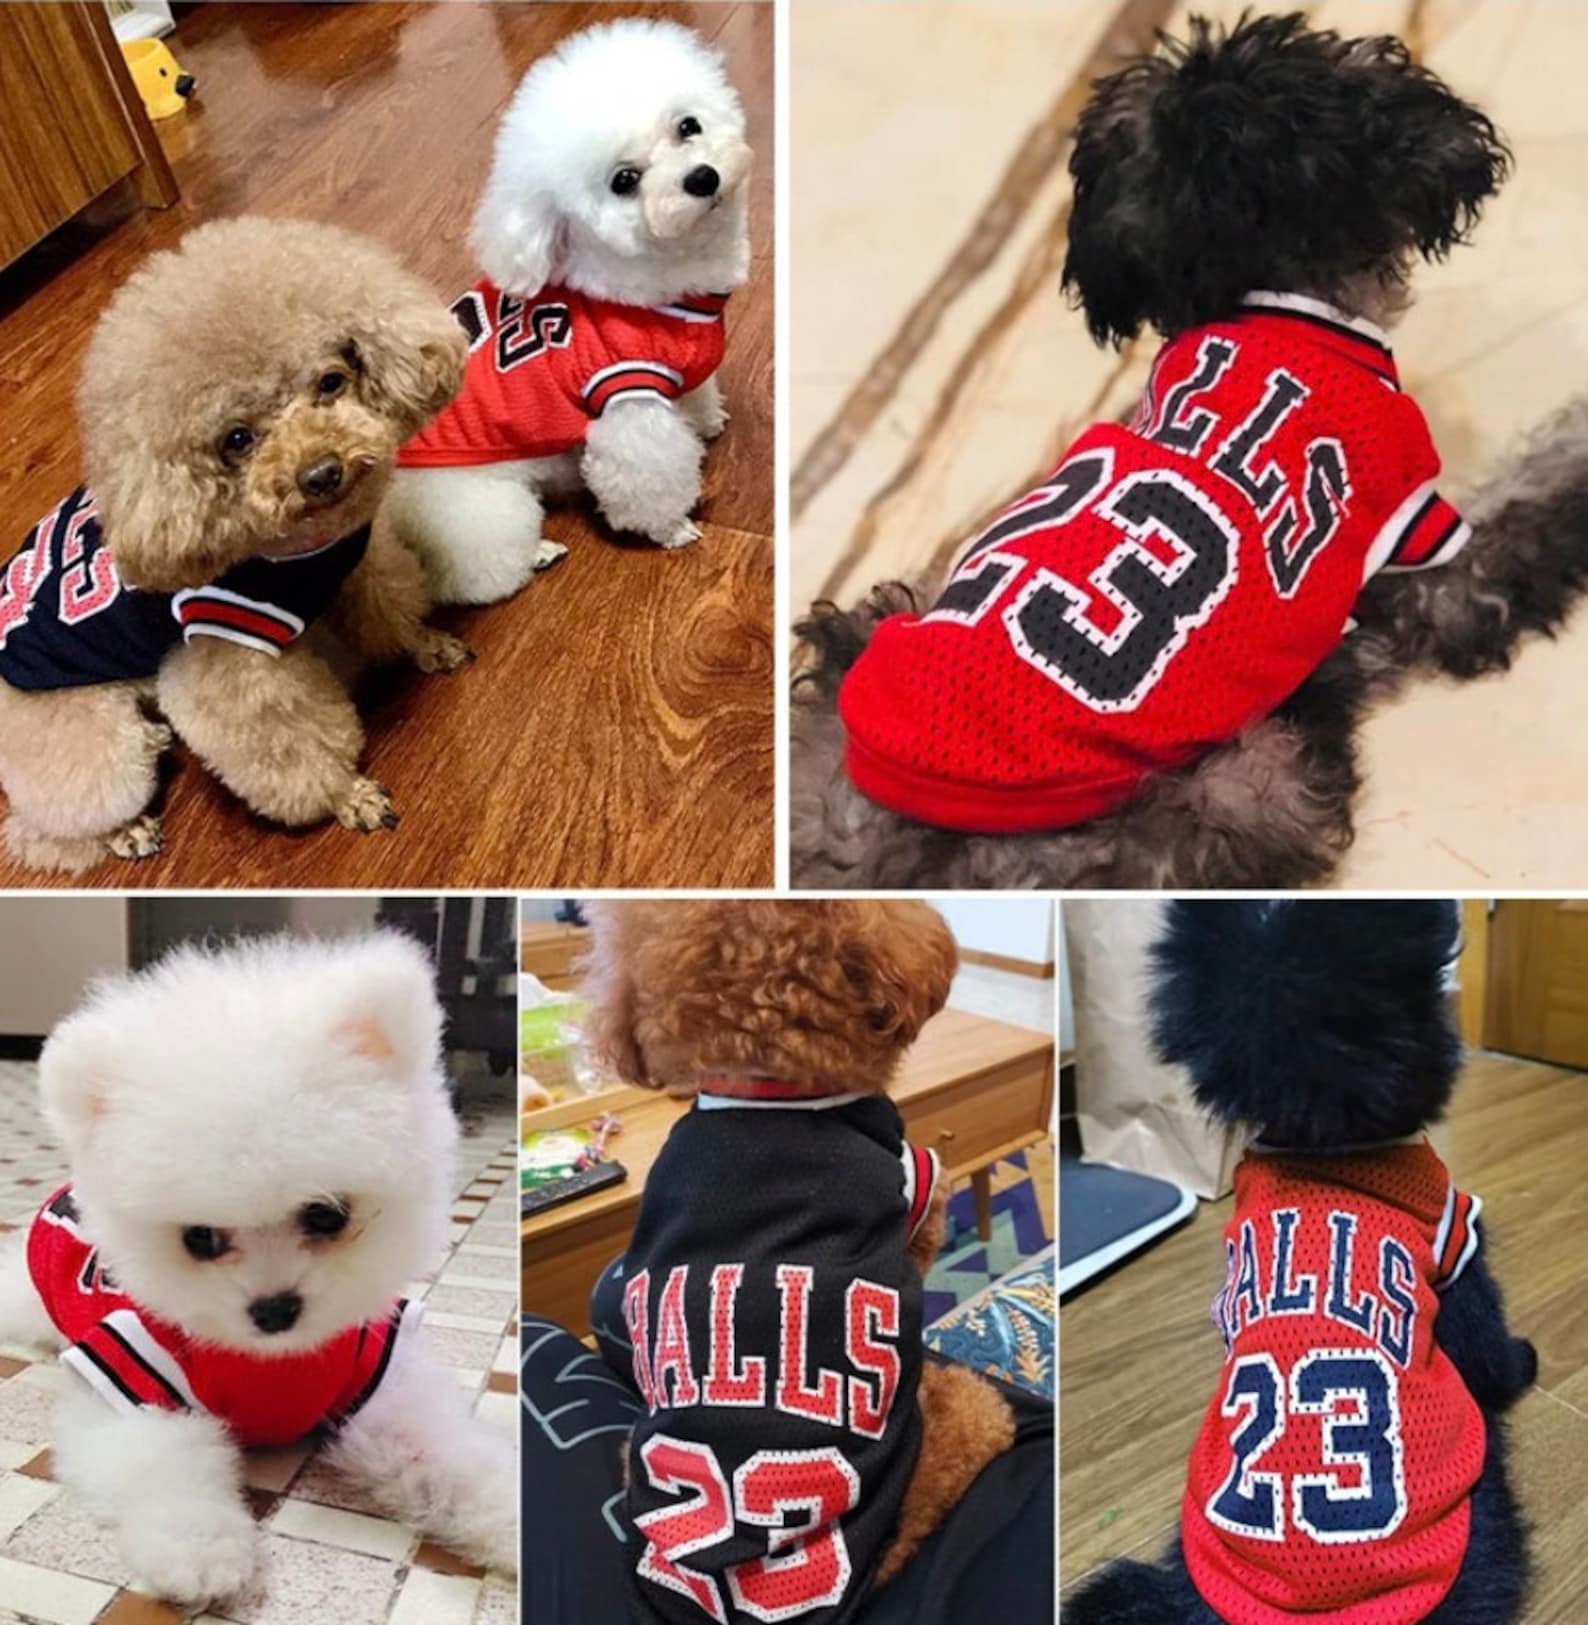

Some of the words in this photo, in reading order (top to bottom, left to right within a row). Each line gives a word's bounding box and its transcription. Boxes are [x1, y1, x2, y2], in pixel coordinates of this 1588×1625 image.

[920, 446, 1240, 713] 23
[1138, 334, 1354, 601] LLS
[632, 1432, 861, 1625] 23
[1205, 1347, 1408, 1544] 23
